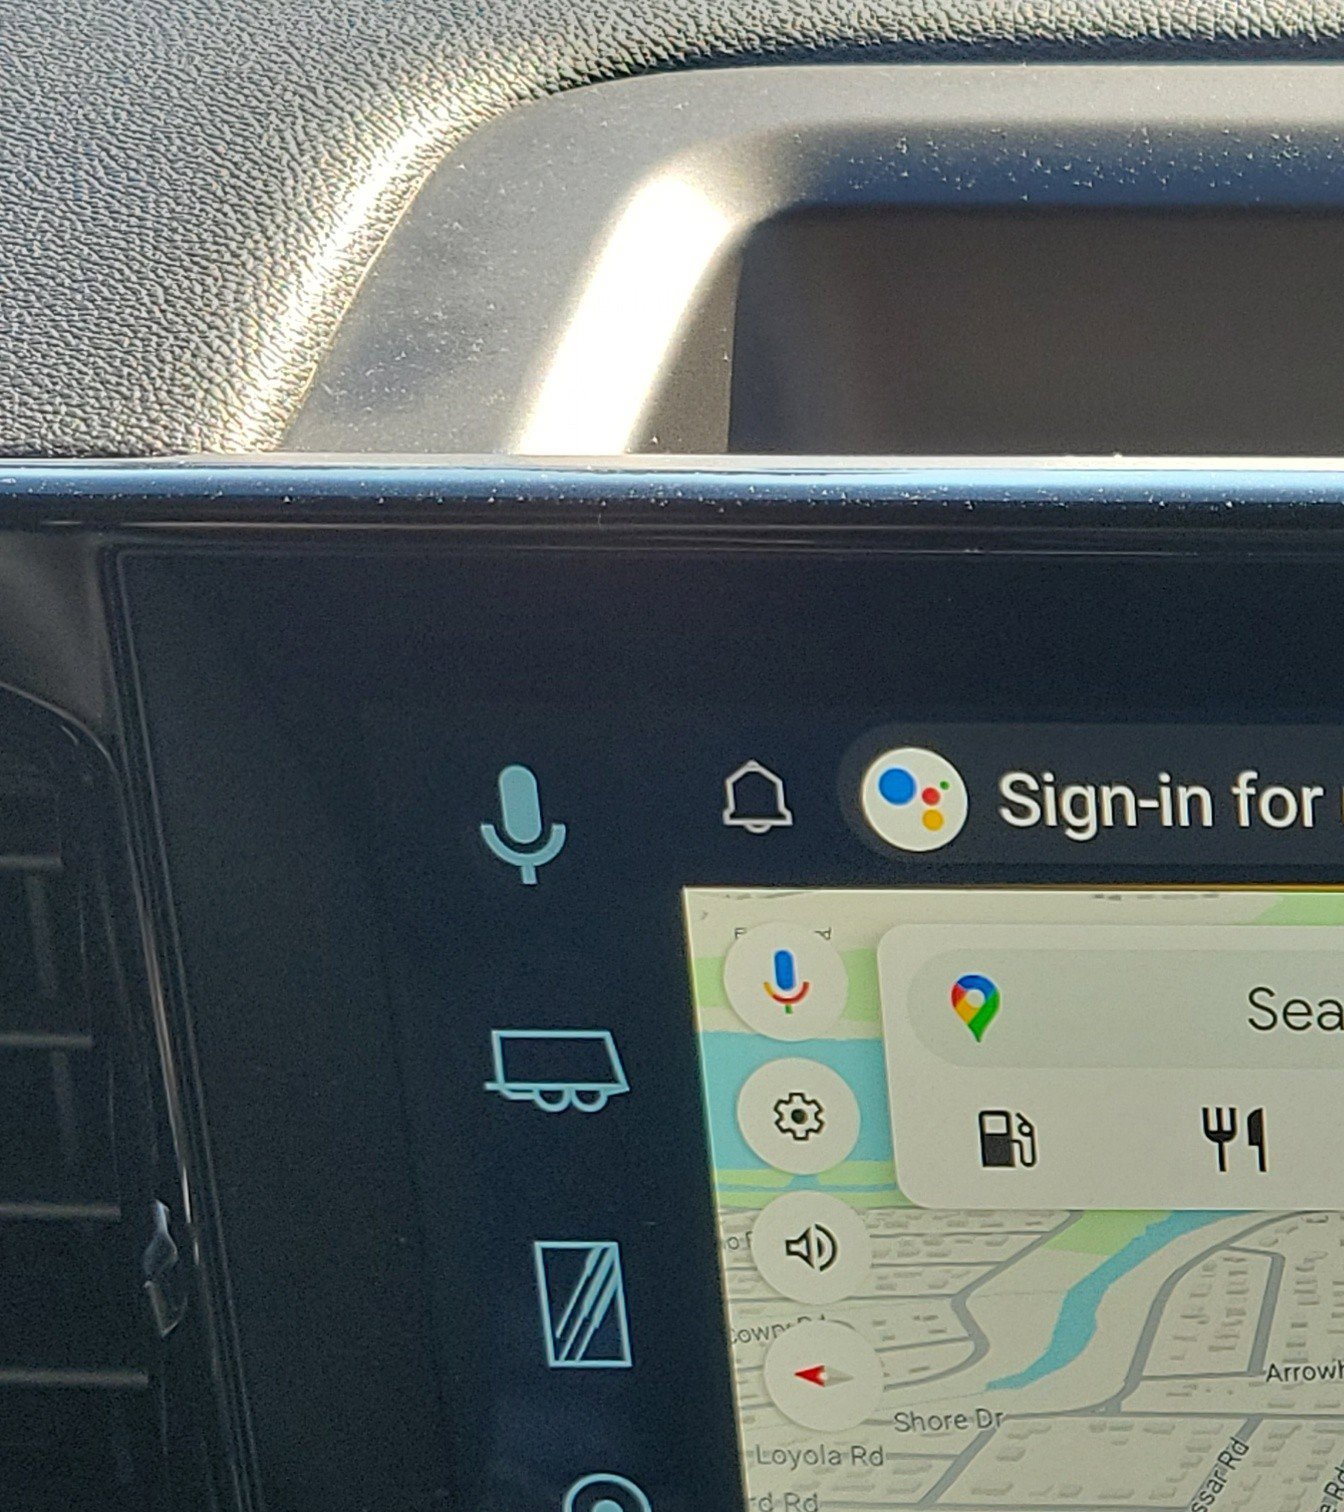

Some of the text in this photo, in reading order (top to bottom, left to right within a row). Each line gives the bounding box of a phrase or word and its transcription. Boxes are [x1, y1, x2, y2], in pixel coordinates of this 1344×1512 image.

[998, 770, 1213, 842] Sign-in
[1233, 769, 1318, 828] for
[894, 1411, 1005, 1433] Shore Dr
[756, 1444, 884, 1471] Loyola Rd
[1219, 1437, 1249, 1470] Rd
